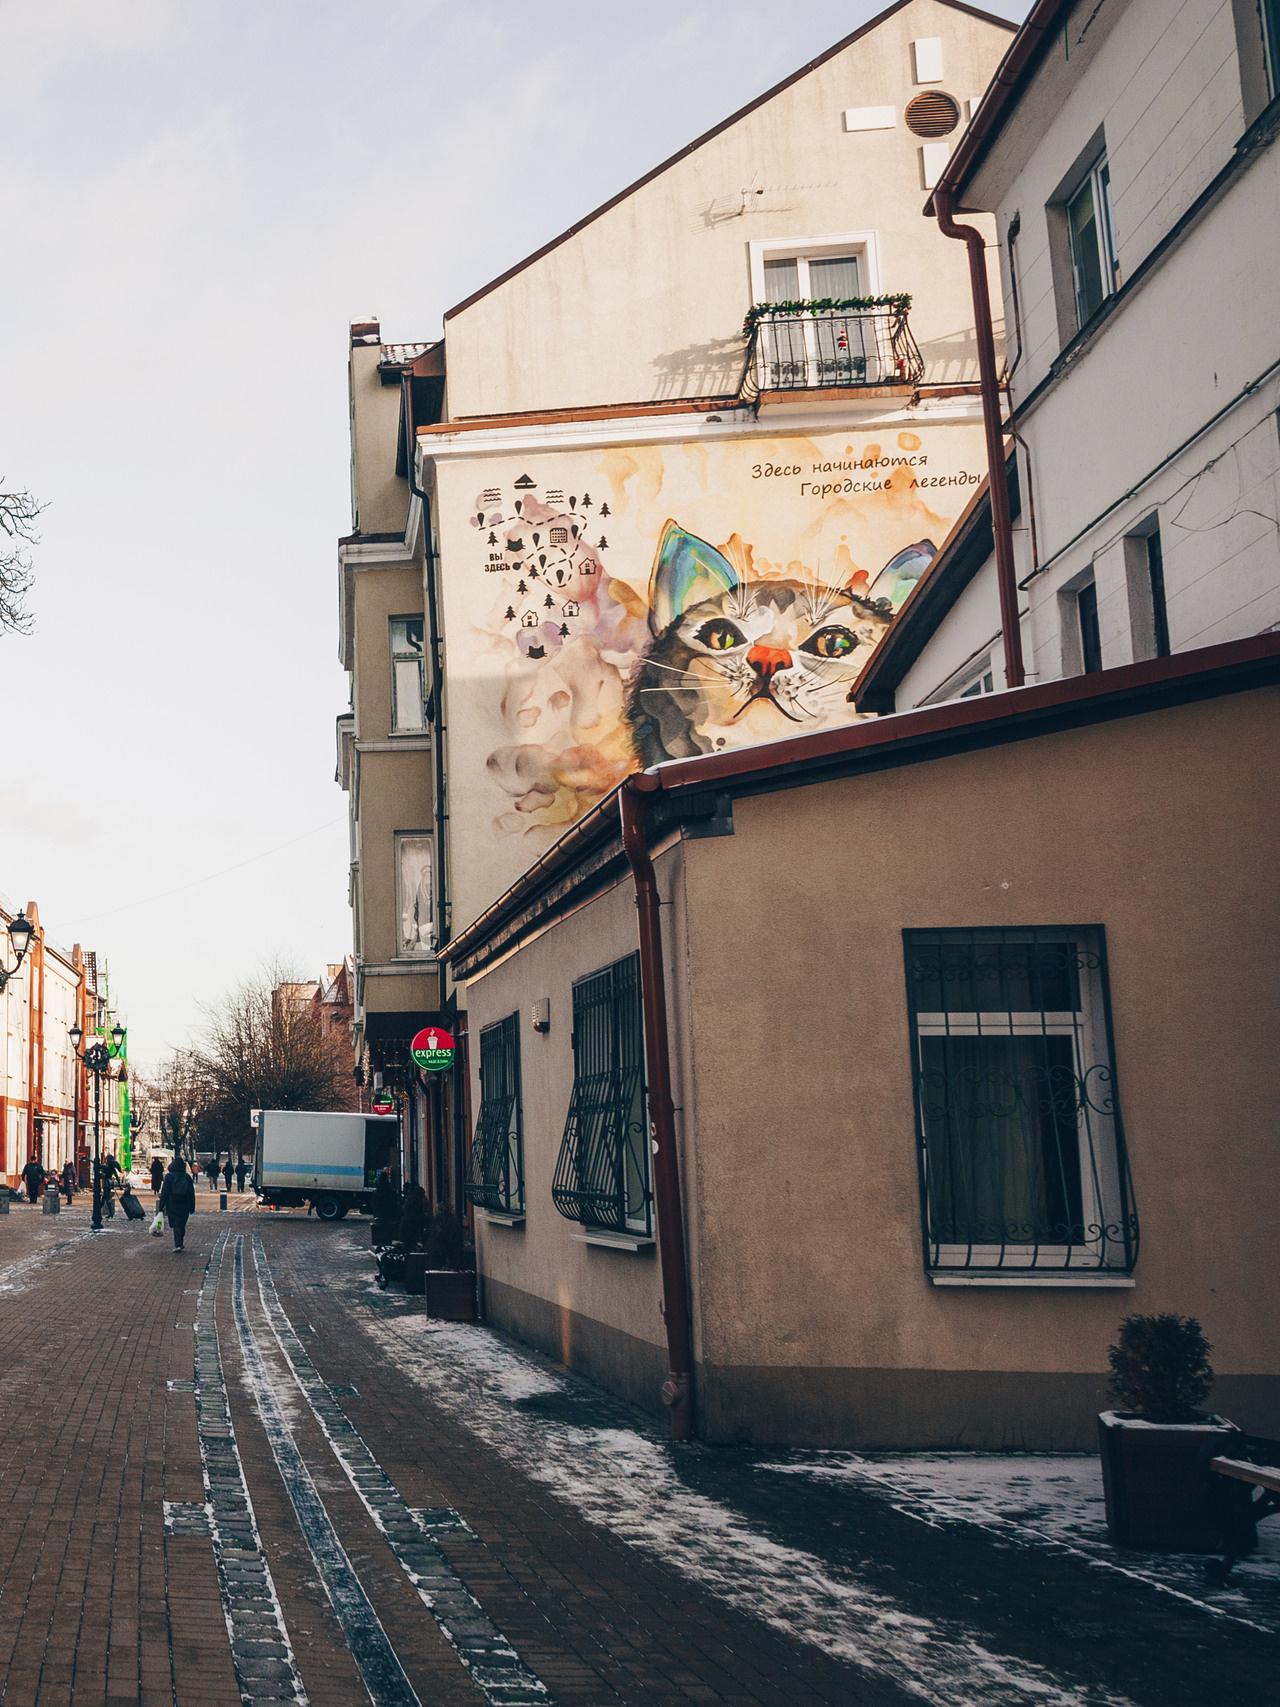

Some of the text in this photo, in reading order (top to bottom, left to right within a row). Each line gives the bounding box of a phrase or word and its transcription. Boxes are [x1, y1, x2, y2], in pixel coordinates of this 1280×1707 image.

[751, 455, 928, 479] Здесь начинаются
[800, 470, 982, 499] Городские легенды
[489, 553, 503, 561] ВЫ
[484, 562, 511, 572] ЗДЕСЬ
[415, 1049, 452, 1059] express
